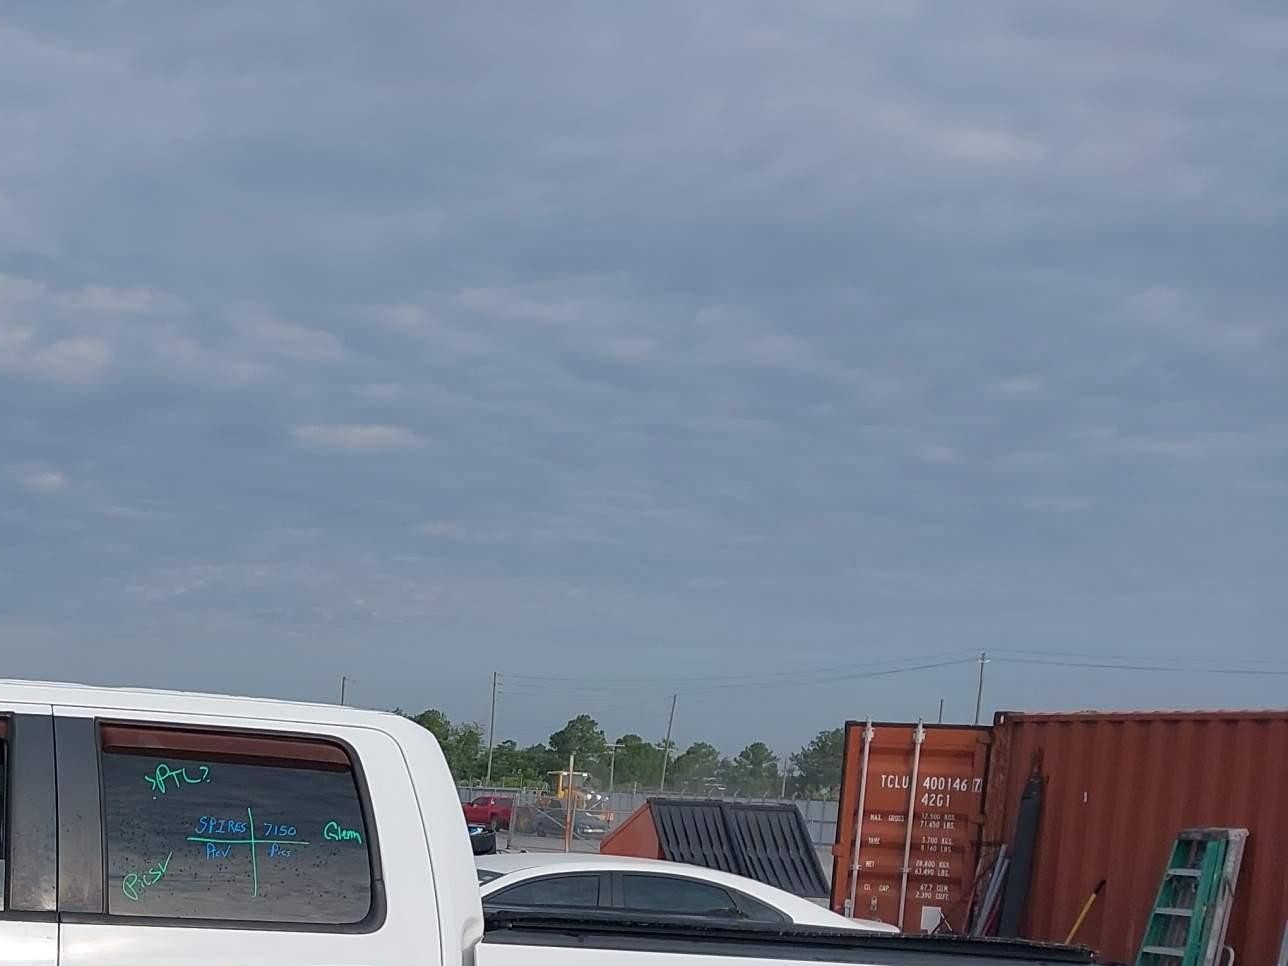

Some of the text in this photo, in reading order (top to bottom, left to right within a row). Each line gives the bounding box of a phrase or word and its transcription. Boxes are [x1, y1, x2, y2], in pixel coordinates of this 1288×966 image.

[880, 774, 910, 789] TCLU
[922, 776, 968, 792] 400146
[921, 792, 950, 808] 42G1
[194, 815, 248, 835] SPIRES
[263, 822, 298, 837] 7150
